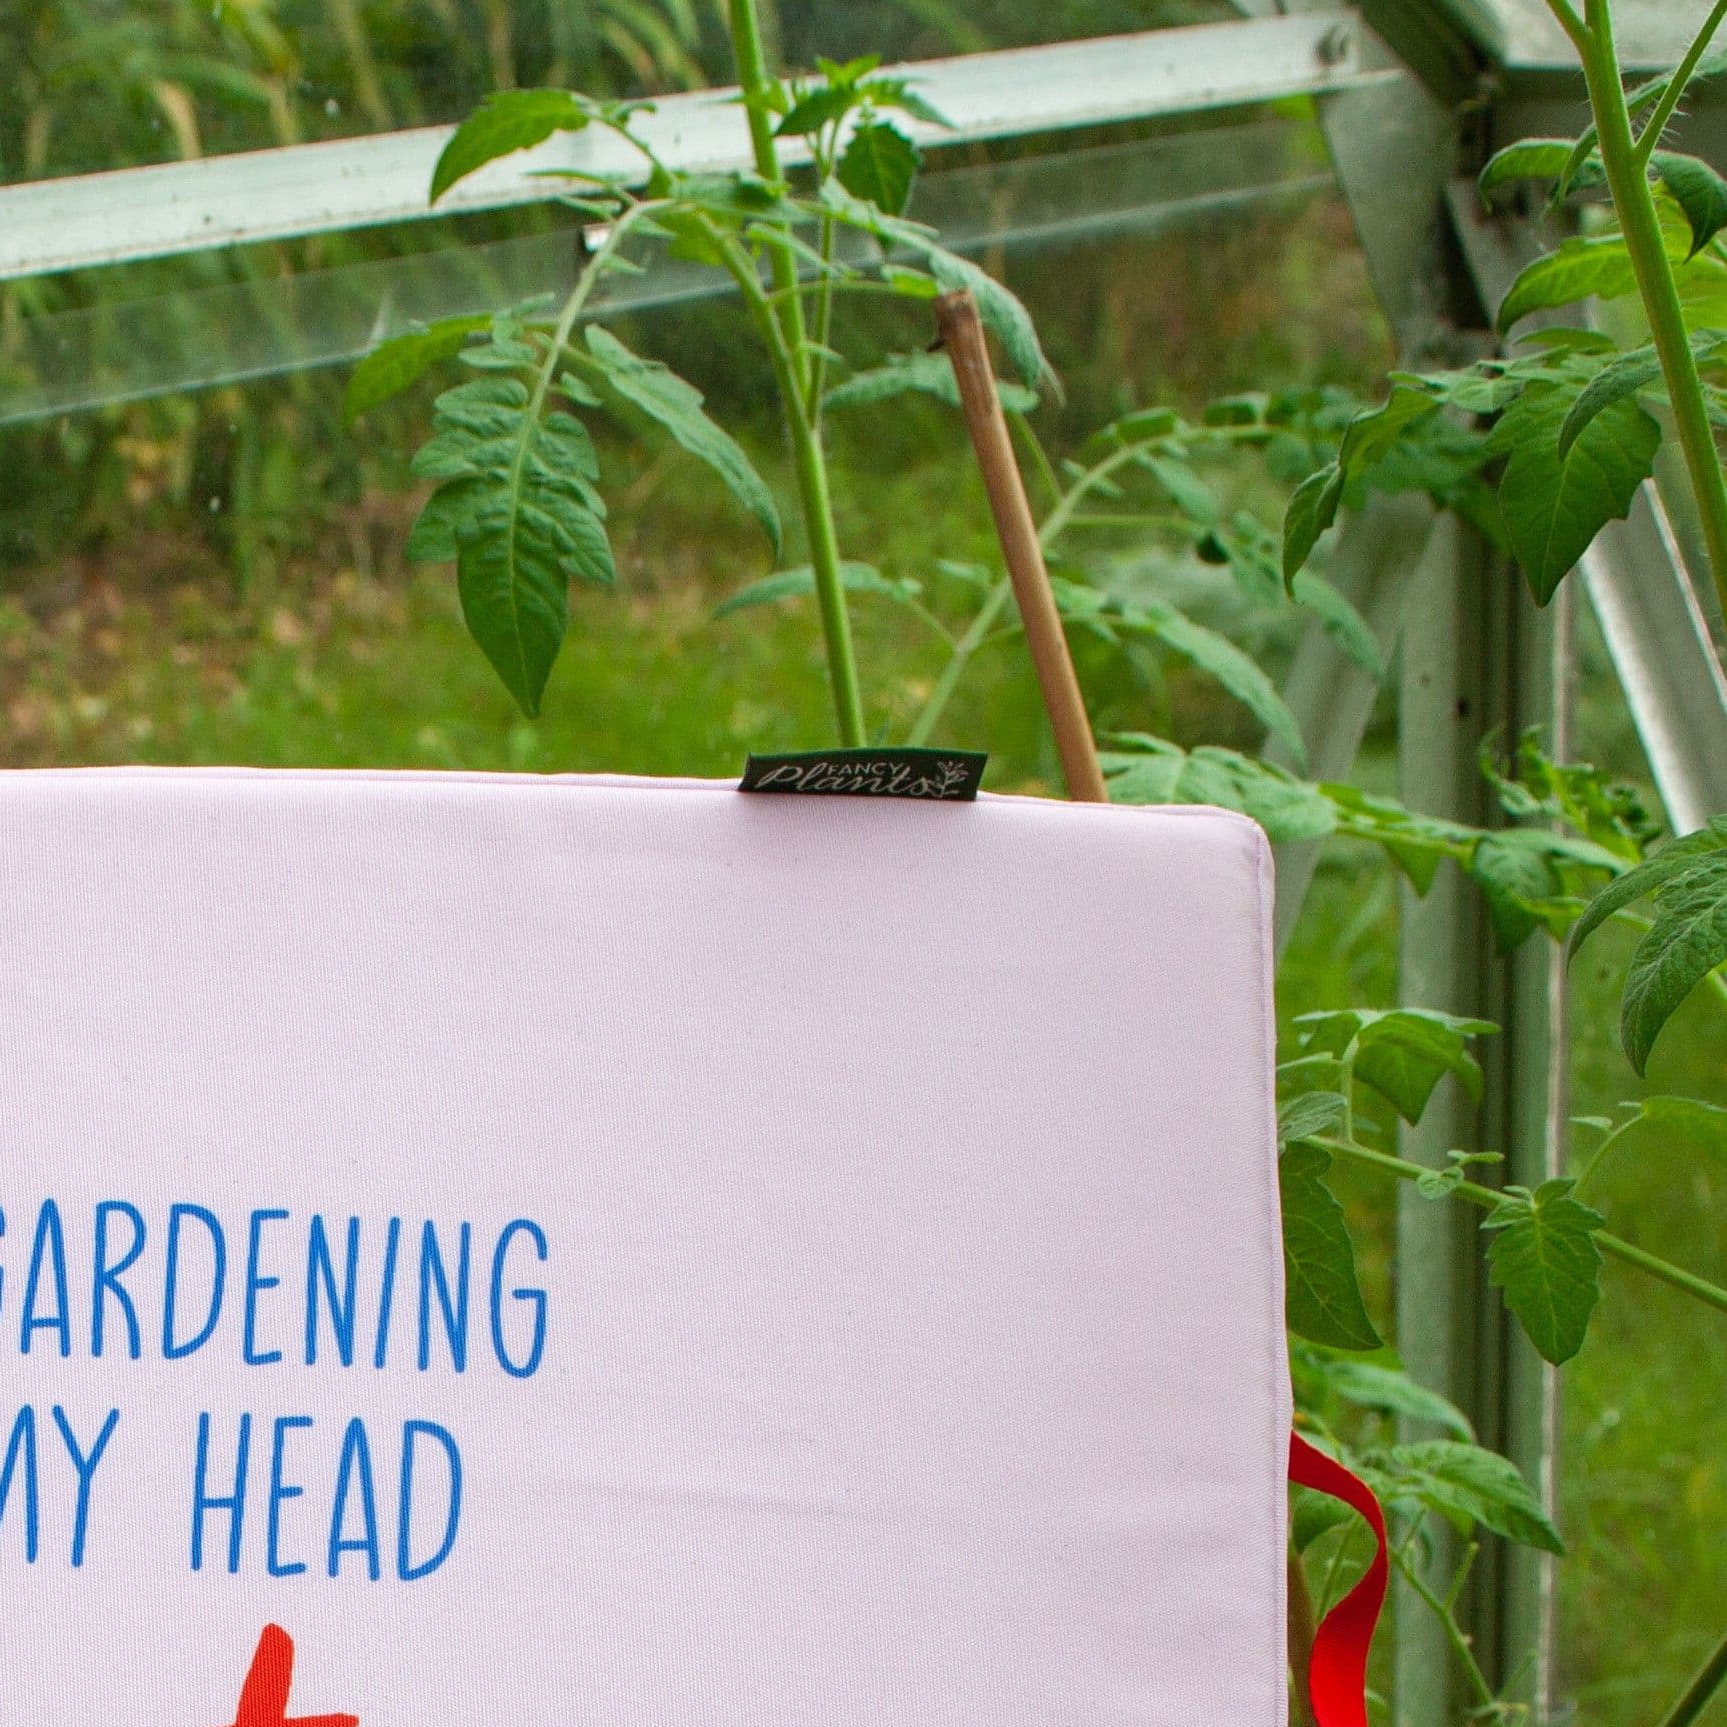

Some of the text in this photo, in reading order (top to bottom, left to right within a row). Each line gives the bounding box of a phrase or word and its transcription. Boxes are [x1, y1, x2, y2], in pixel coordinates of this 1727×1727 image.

[753, 760, 934, 797] Plants
[826, 761, 903, 775] FANCY
[190, 1411, 463, 1582] HEAD
